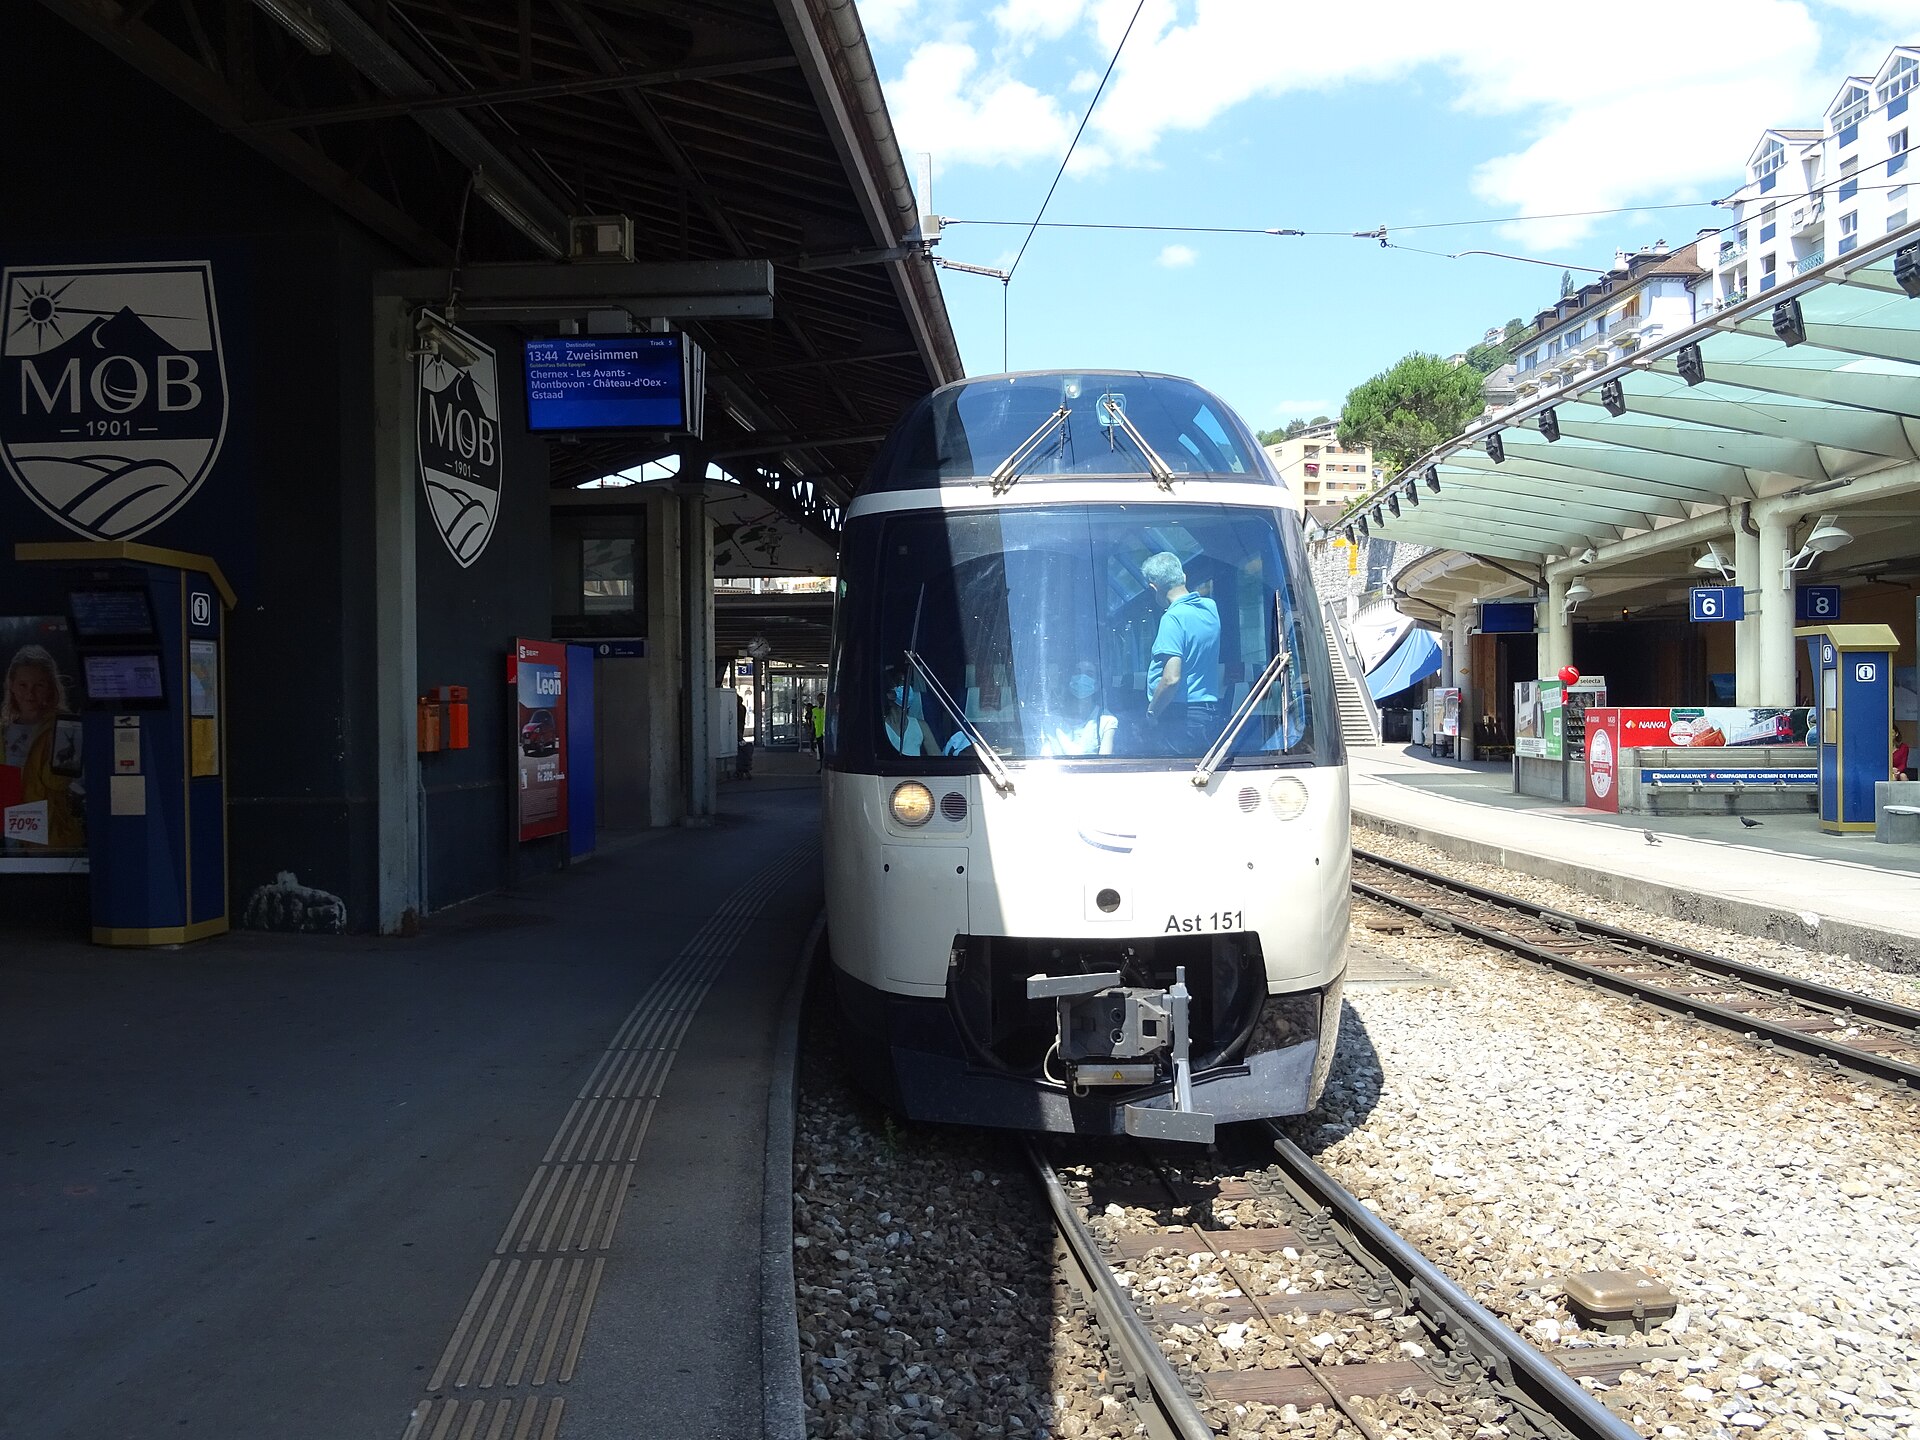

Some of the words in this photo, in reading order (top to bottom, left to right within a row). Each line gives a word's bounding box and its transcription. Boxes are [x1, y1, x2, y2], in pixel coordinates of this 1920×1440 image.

[528, 350, 558, 361] 13:44
[566, 350, 639, 361] Zweisimmen
[530, 370, 569, 379] Chernex
[576, 369, 591, 378] Les
[593, 369, 626, 378] Avants
[21, 355, 202, 415] MOB
[531, 380, 586, 389] Montbovon
[593, 378, 662, 388] Château-d'Oex
[532, 390, 564, 399] Gstaad
[86, 420, 132, 437] 1901
[429, 393, 495, 467] MOB
[454, 460, 471, 478] 1901
[1702, 597, 1716, 616] 6
[1816, 597, 1829, 614] 8
[741, 665, 748, 674] 3
[536, 671, 562, 696] Leon
[1638, 721, 1667, 729] NANKAI
[1164, 914, 1202, 933] Ast
[1210, 911, 1242, 930] 151
